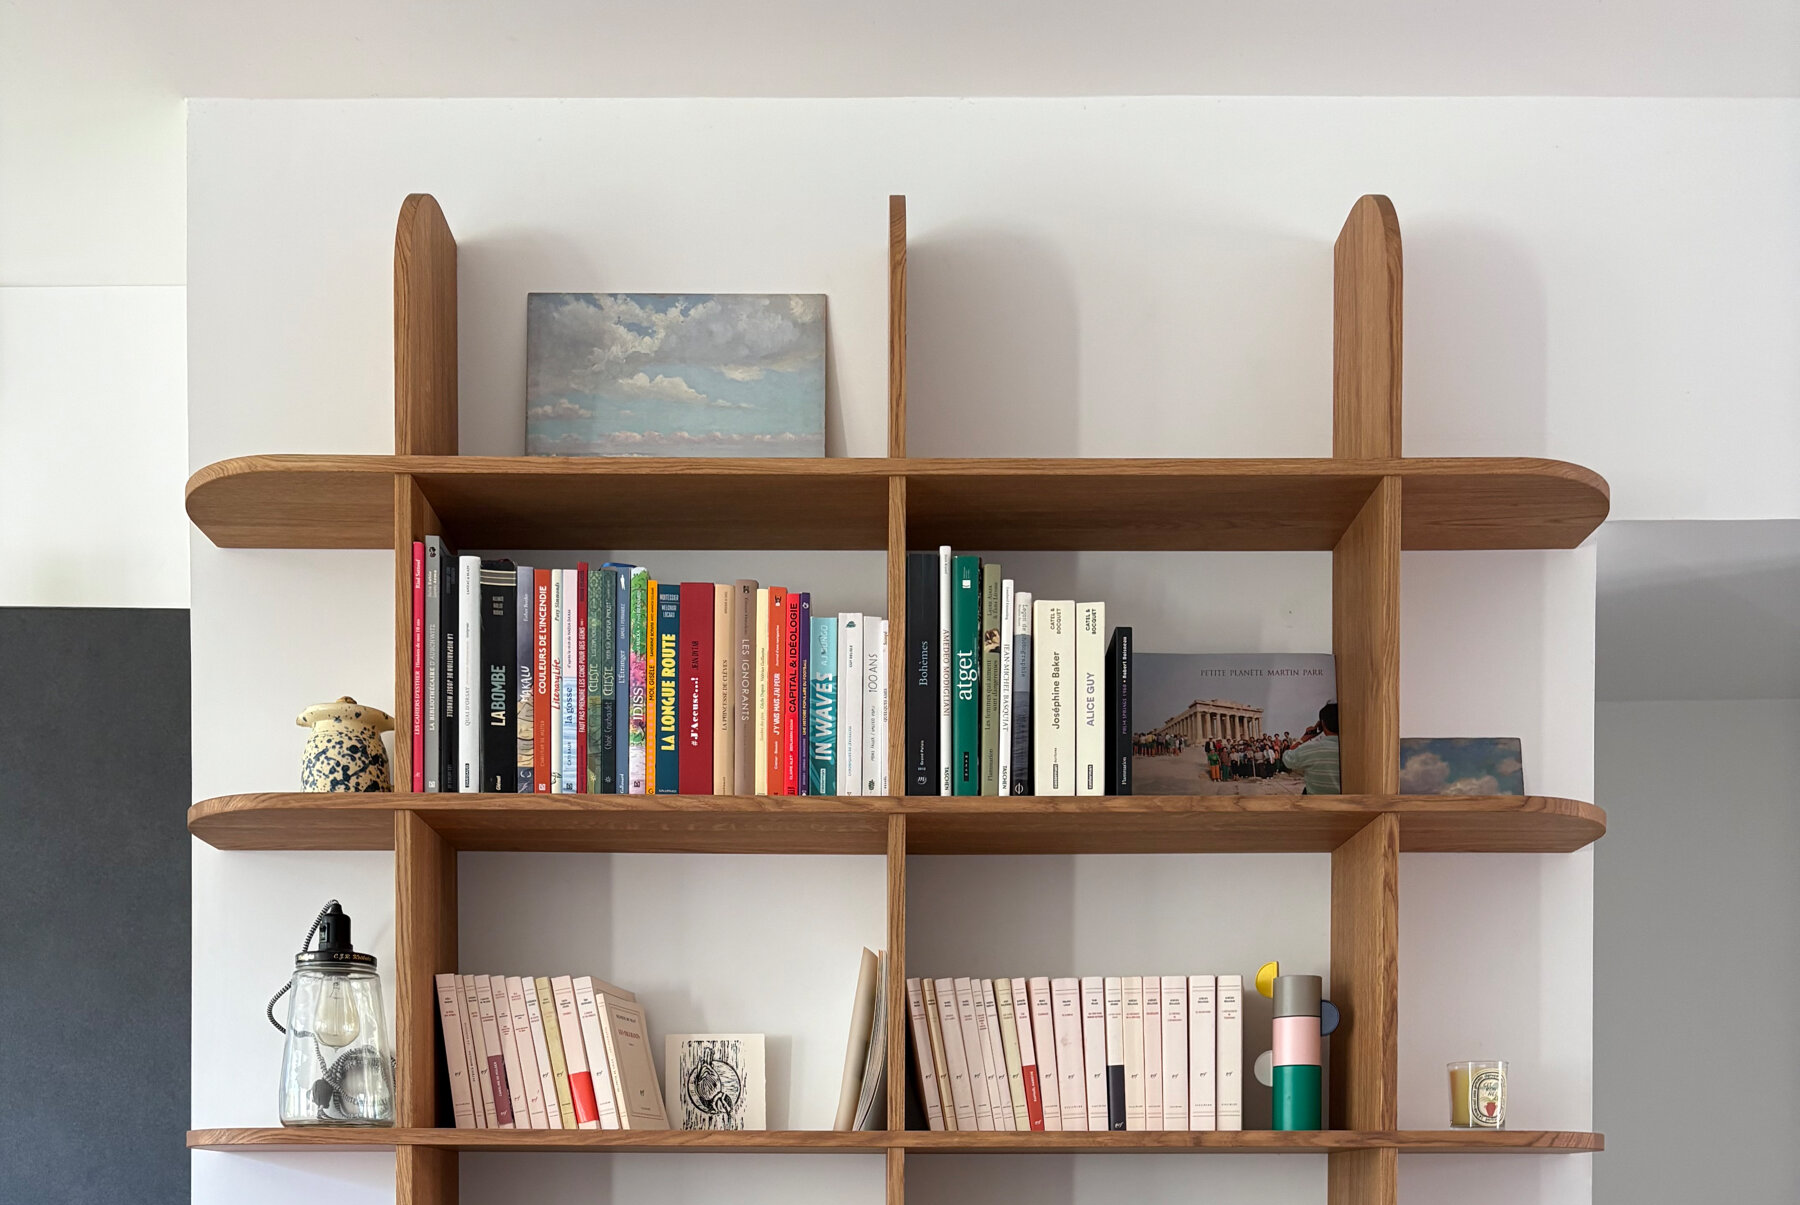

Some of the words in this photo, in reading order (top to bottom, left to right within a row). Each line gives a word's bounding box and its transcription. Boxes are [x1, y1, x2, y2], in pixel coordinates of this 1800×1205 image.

[538, 586, 547, 634] L'INCENDIE
[1020, 604, 1028, 621] Leçon
[538, 634, 546, 646] DE
[788, 603, 797, 658] IDÉOLOGIE
[661, 634, 676, 677] ROUTE
[868, 654, 878, 673] ANS
[918, 641, 928, 686] Bohèmes
[1052, 651, 1060, 678] Baker
[520, 666, 532, 702] MAKALU
[538, 648, 546, 694] COULEURS
[868, 675, 878, 693] 100
[956, 650, 978, 700] atget
[1086, 672, 1094, 694] GUY
[566, 688, 574, 714] gosse
[633, 688, 643, 720] IDISS
[789, 670, 797, 712] CAPITAL
[816, 672, 832, 737] WAVES
[1051, 681, 1061, 729] Joséphine
[564, 714, 572, 724] la
[661, 680, 675, 732] LONGUE
[1086, 697, 1094, 726] ALICE
[429, 722, 435, 730] LA
[722, 721, 728, 731] LA
[661, 735, 675, 750] LA
[816, 743, 832, 760] IN
